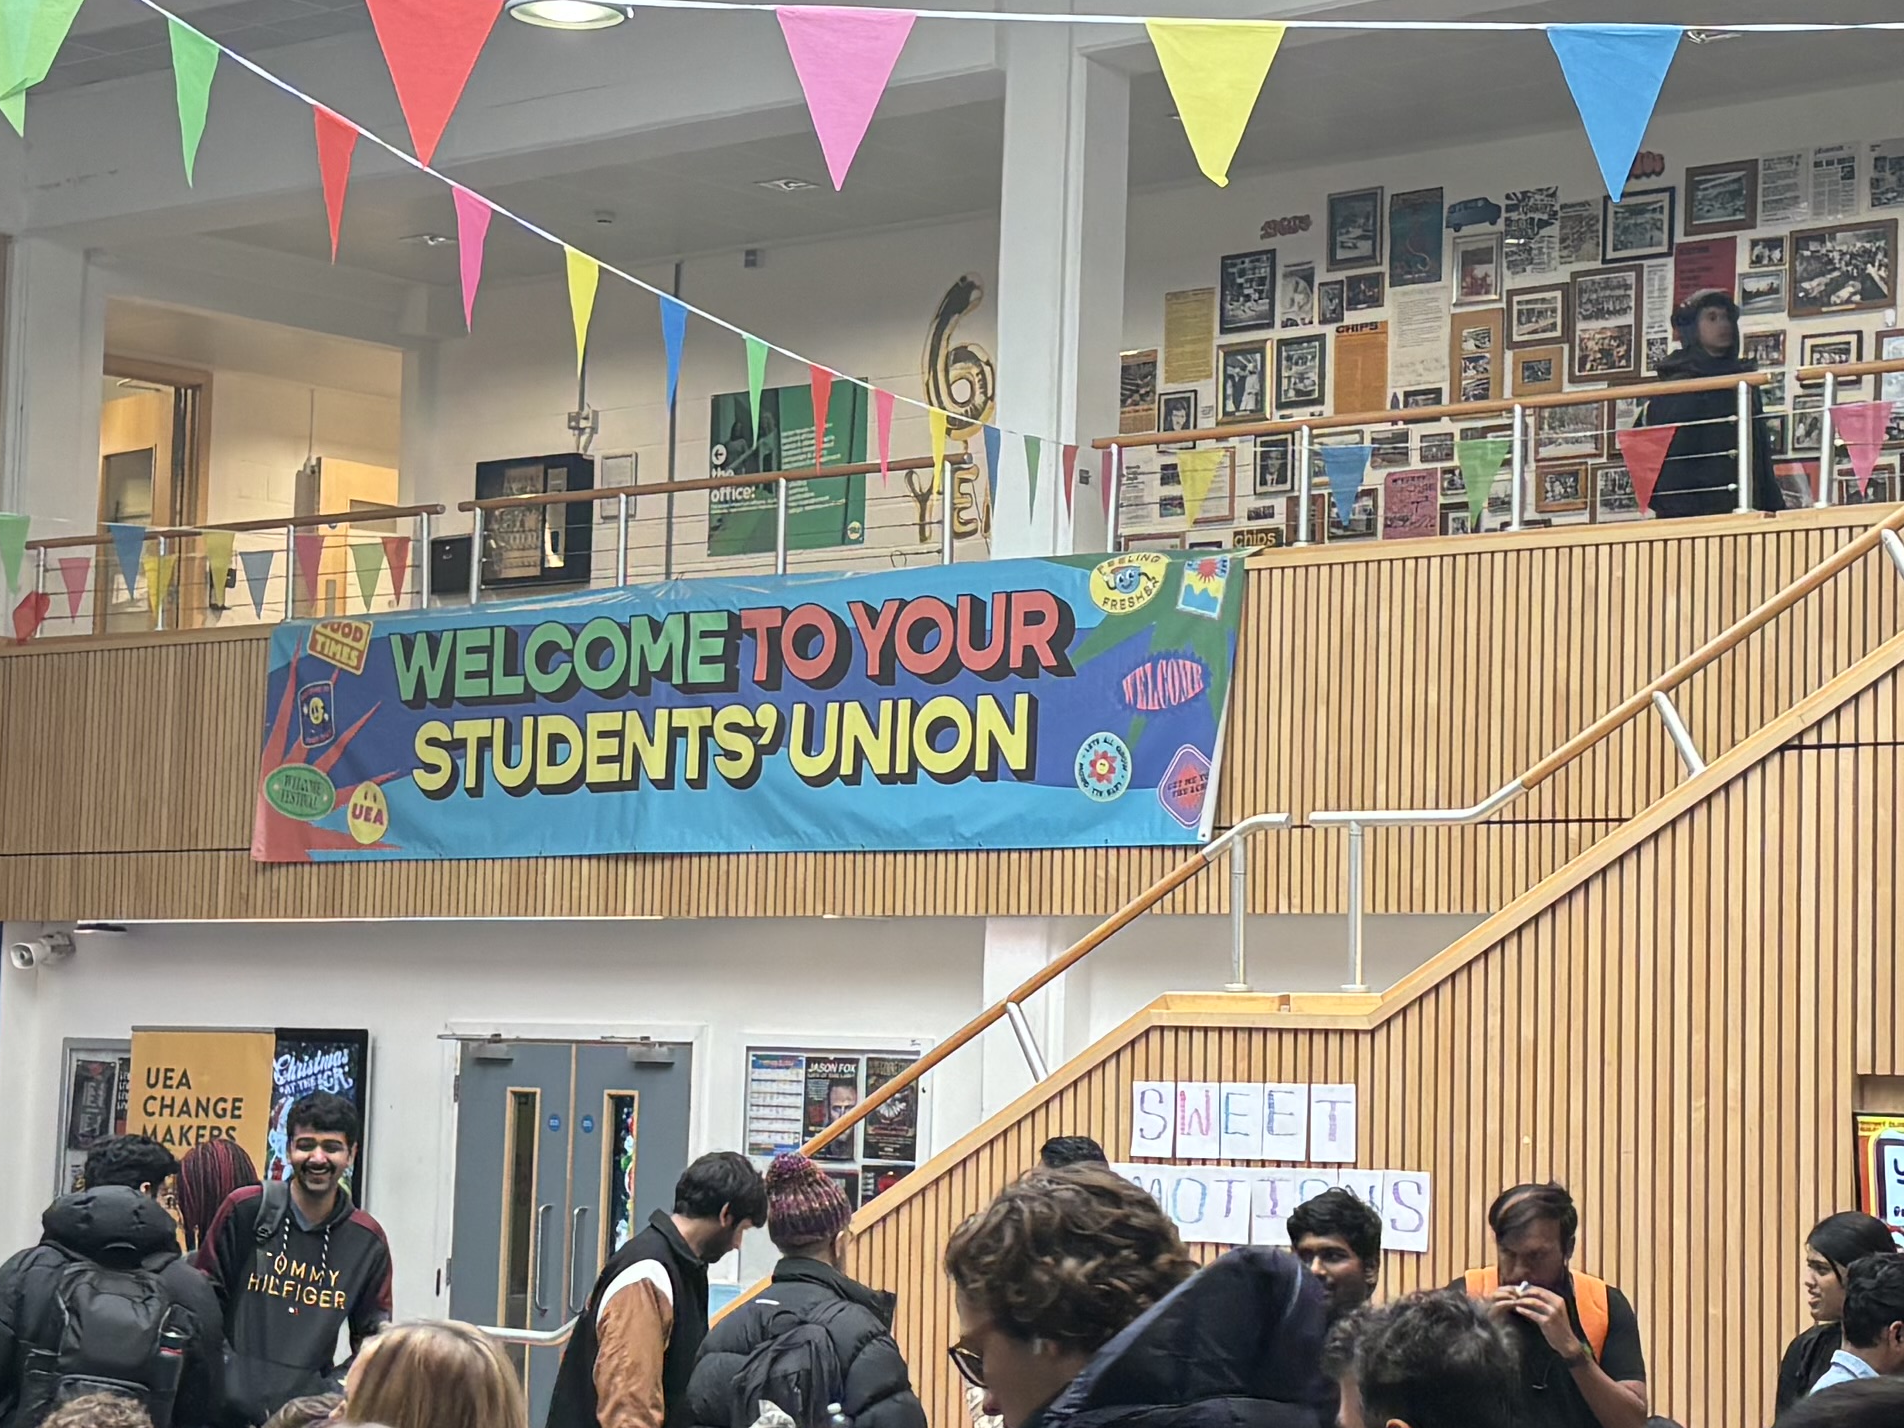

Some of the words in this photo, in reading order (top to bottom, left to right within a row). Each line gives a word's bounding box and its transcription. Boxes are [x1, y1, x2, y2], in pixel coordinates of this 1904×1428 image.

[1335, 321, 1380, 334] CHIPS
[710, 486, 756, 502] office:
[314, 635, 360, 667] TIMES
[388, 610, 730, 706] WELCOME
[739, 603, 840, 684] TO
[849, 588, 1060, 677] YOUR
[1122, 658, 1205, 711] WELCOME
[787, 692, 1032, 780] UNION
[351, 803, 385, 826] UEA
[144, 1066, 192, 1091] UEA
[273, 1048, 350, 1086] Christmas
[807, 1062, 837, 1072] JASON
[838, 1063, 857, 1073] FOX
[142, 1094, 244, 1120] CHANGE
[1139, 1088, 1352, 1142] SWEET
[247, 1272, 346, 1310] HILFIGER
